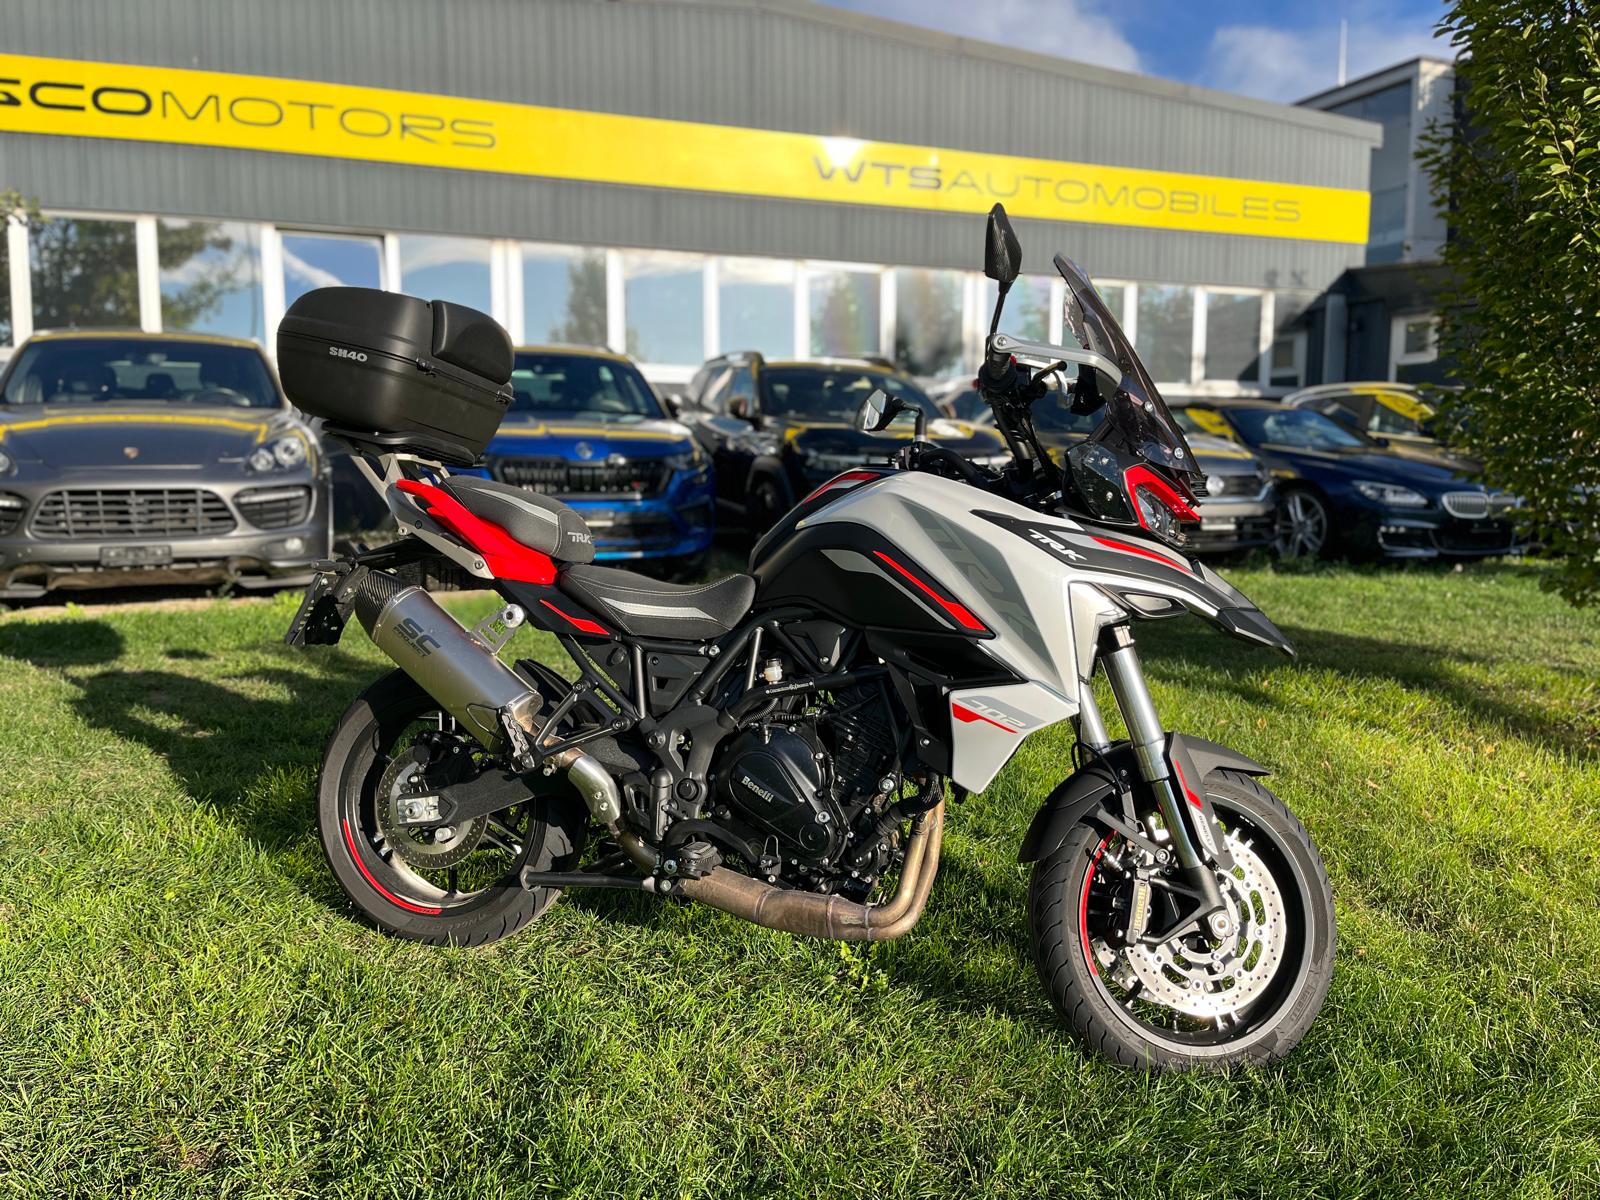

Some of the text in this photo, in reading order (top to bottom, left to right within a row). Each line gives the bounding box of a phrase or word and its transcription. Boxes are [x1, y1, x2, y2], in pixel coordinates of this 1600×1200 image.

[329, 346, 368, 362] SH40
[567, 531, 592, 545] TRK
[1028, 528, 1088, 561] TRK
[397, 617, 441, 656] SC
[741, 775, 774, 803] Benelli
